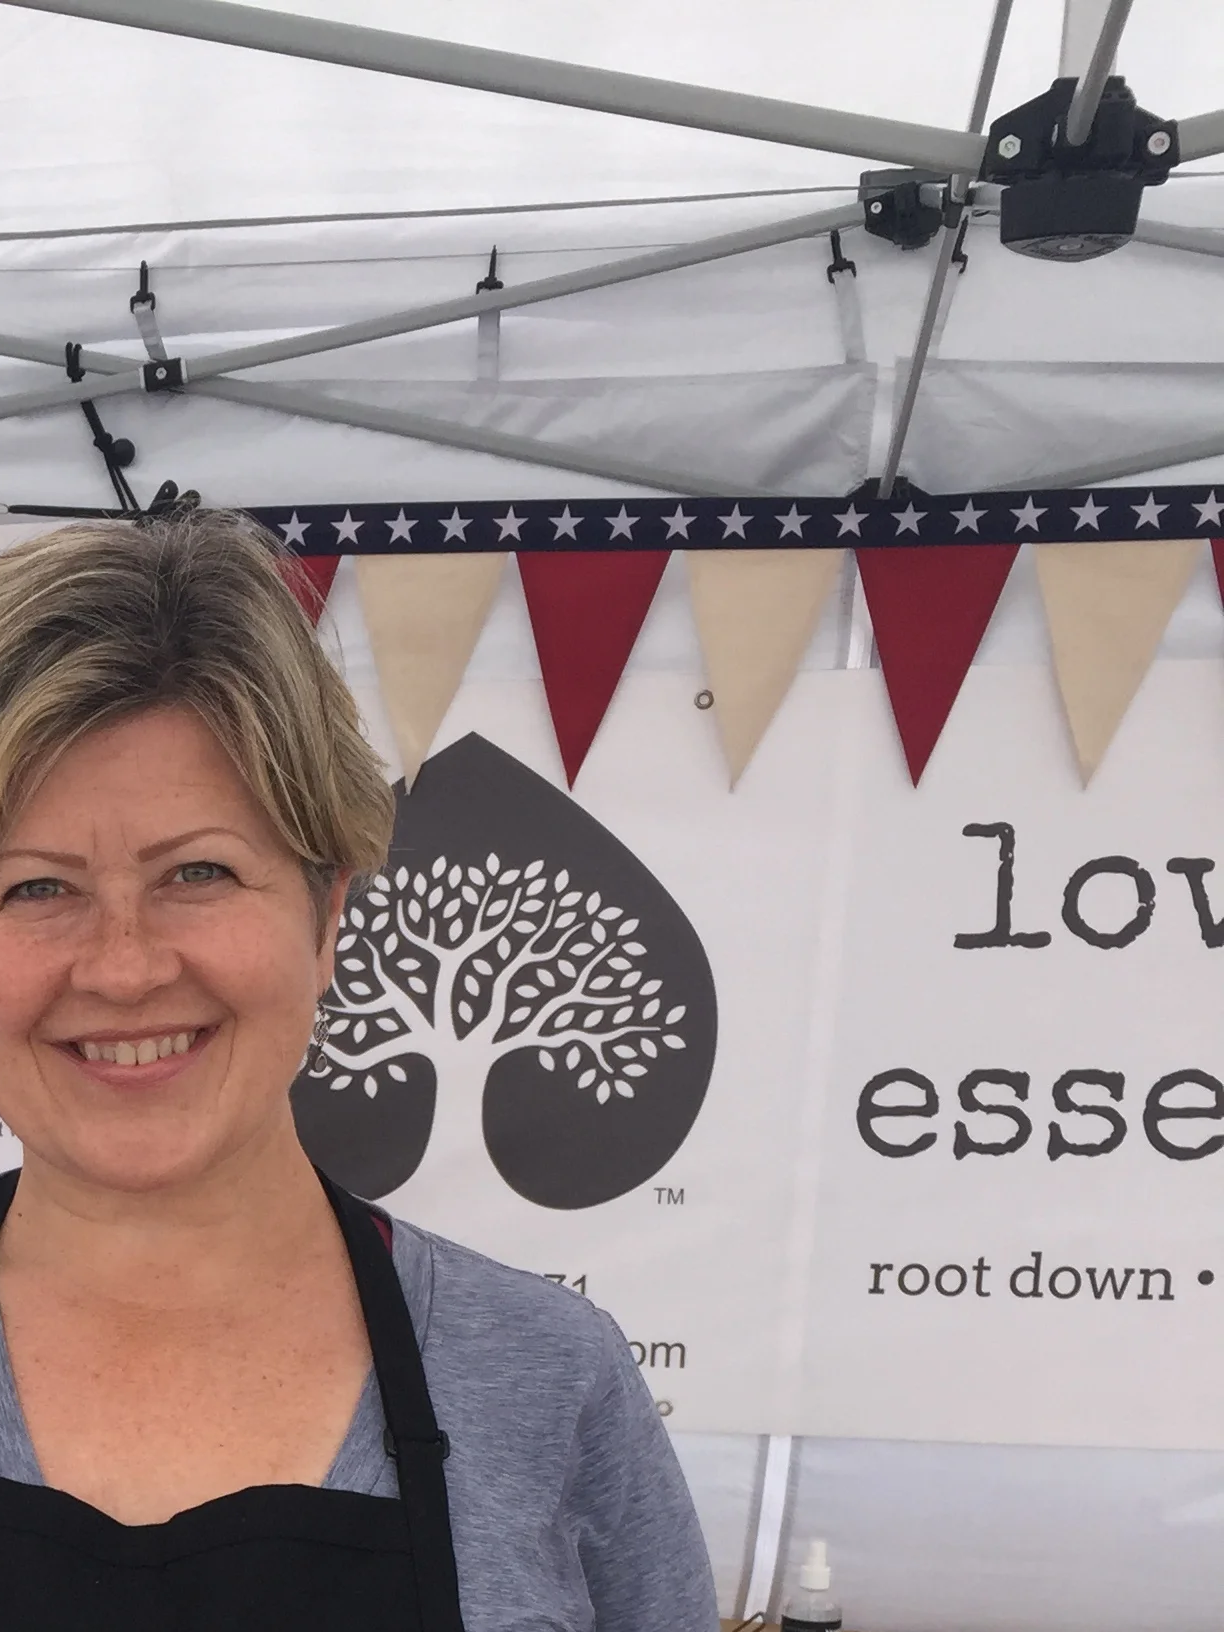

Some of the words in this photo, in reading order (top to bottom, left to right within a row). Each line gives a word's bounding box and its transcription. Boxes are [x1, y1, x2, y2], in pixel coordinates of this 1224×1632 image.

[654, 1187, 685, 1205] TM
[868, 1257, 992, 1298] root
[1009, 1252, 1175, 1301] down
